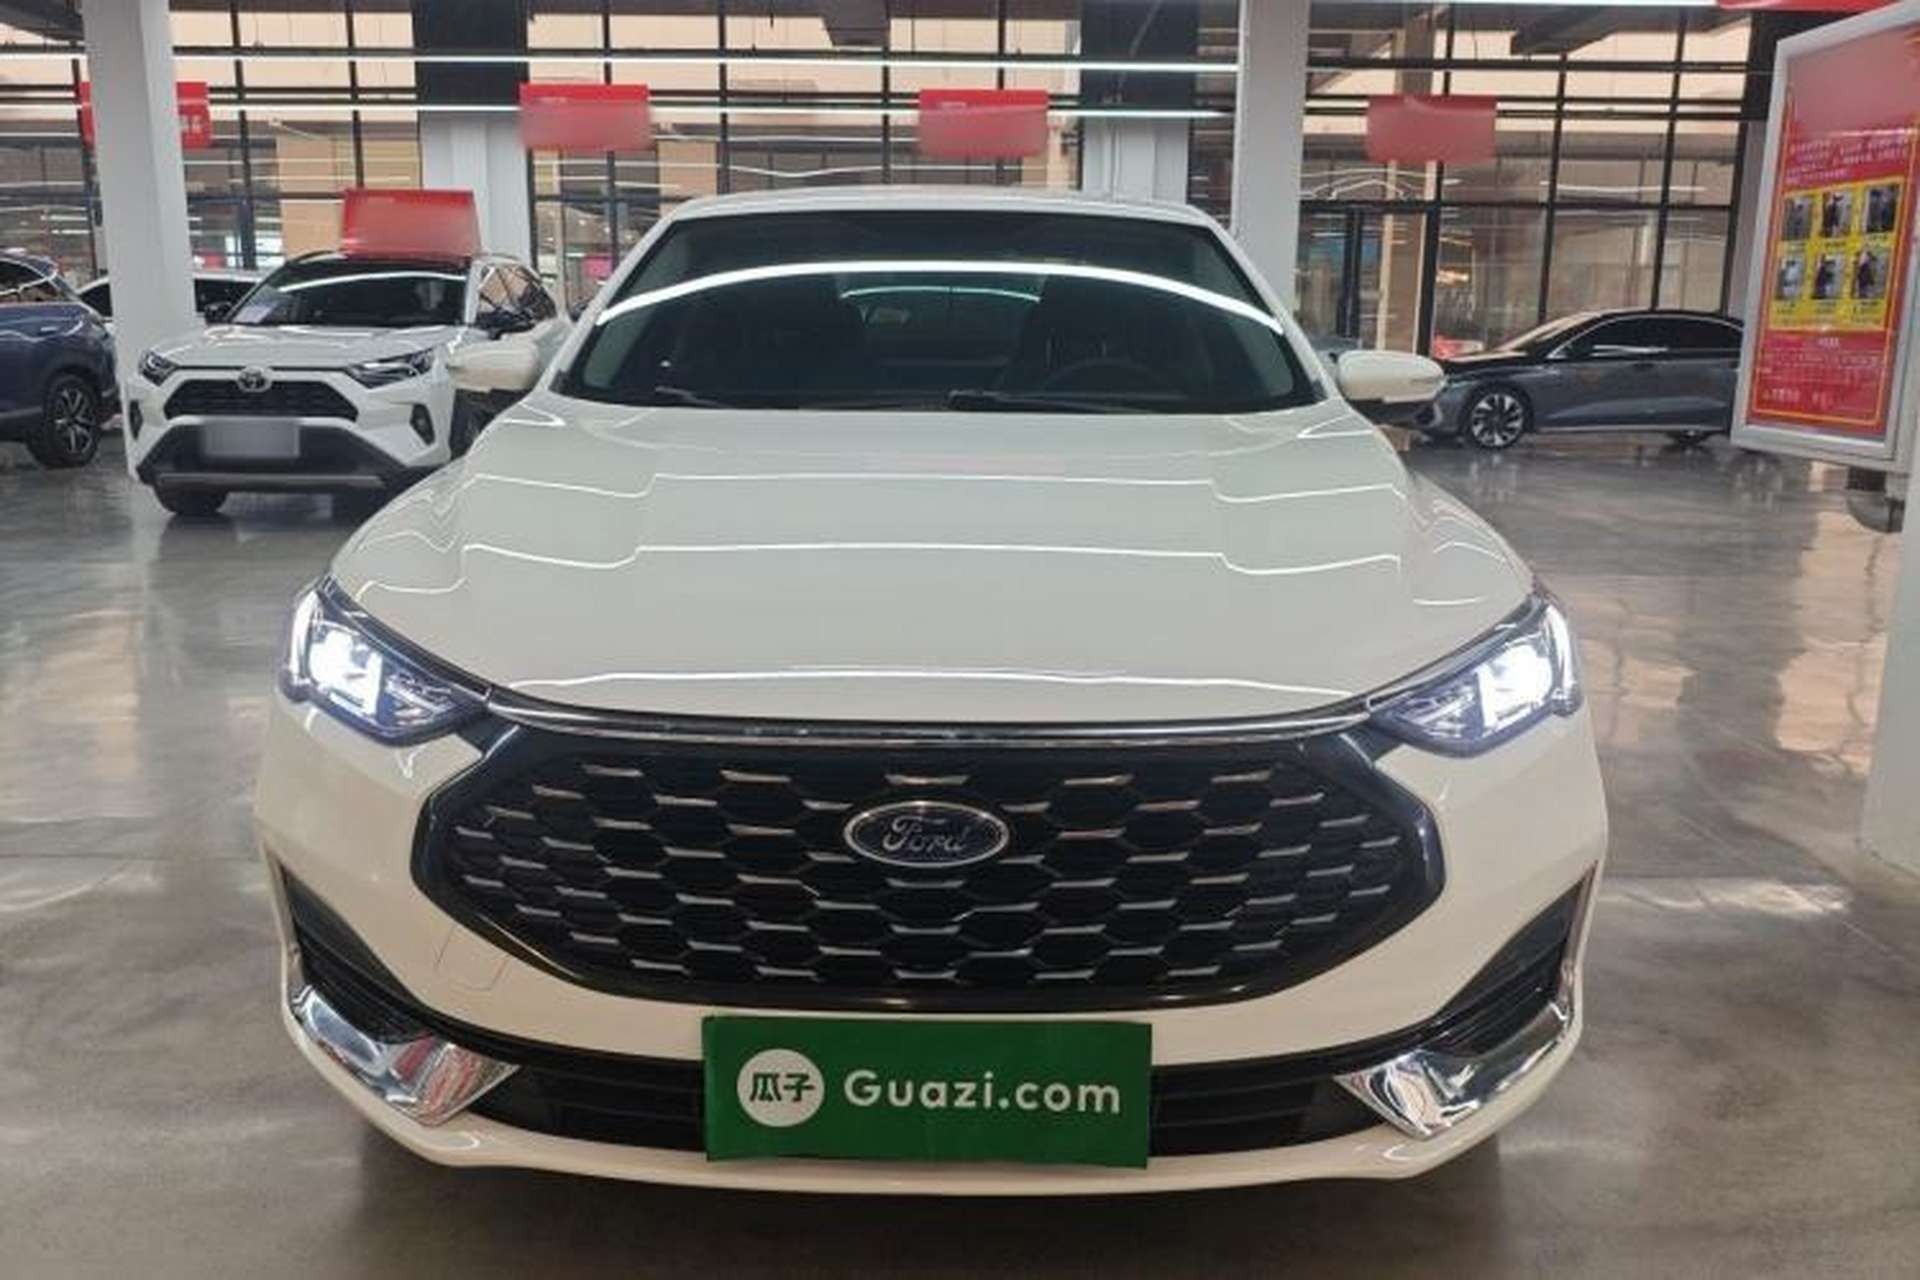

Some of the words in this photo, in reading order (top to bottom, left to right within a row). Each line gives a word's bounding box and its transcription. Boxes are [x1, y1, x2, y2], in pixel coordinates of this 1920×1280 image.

[883, 815, 971, 851] Ford
[750, 1072, 815, 1102] 瓜子
[844, 1069, 1120, 1114] Guazi.com
